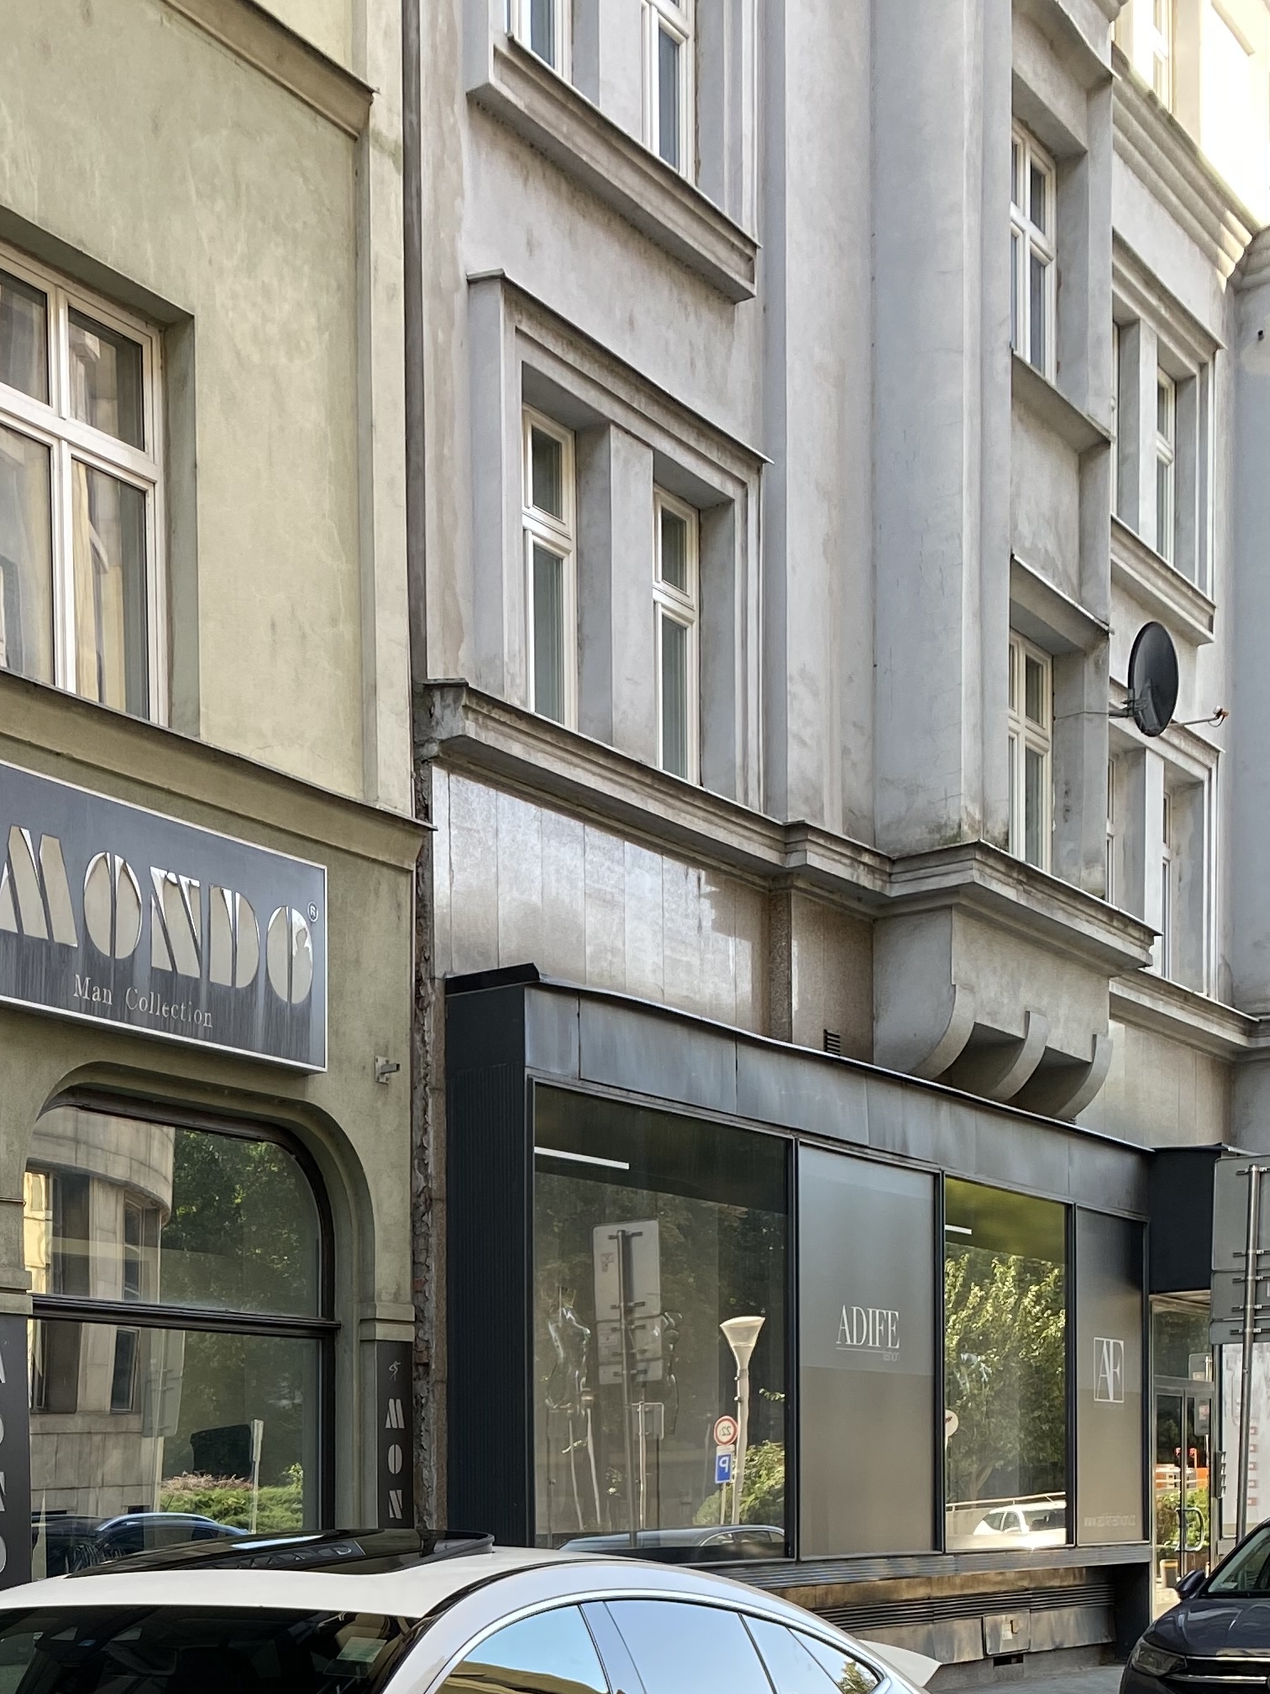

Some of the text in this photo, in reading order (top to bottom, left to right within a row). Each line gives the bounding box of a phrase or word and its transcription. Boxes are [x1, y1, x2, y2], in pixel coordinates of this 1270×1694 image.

[73, 973, 214, 1028] Man Collection
[836, 1304, 900, 1349] ADIFE
[385, 1398, 405, 1520] MON
